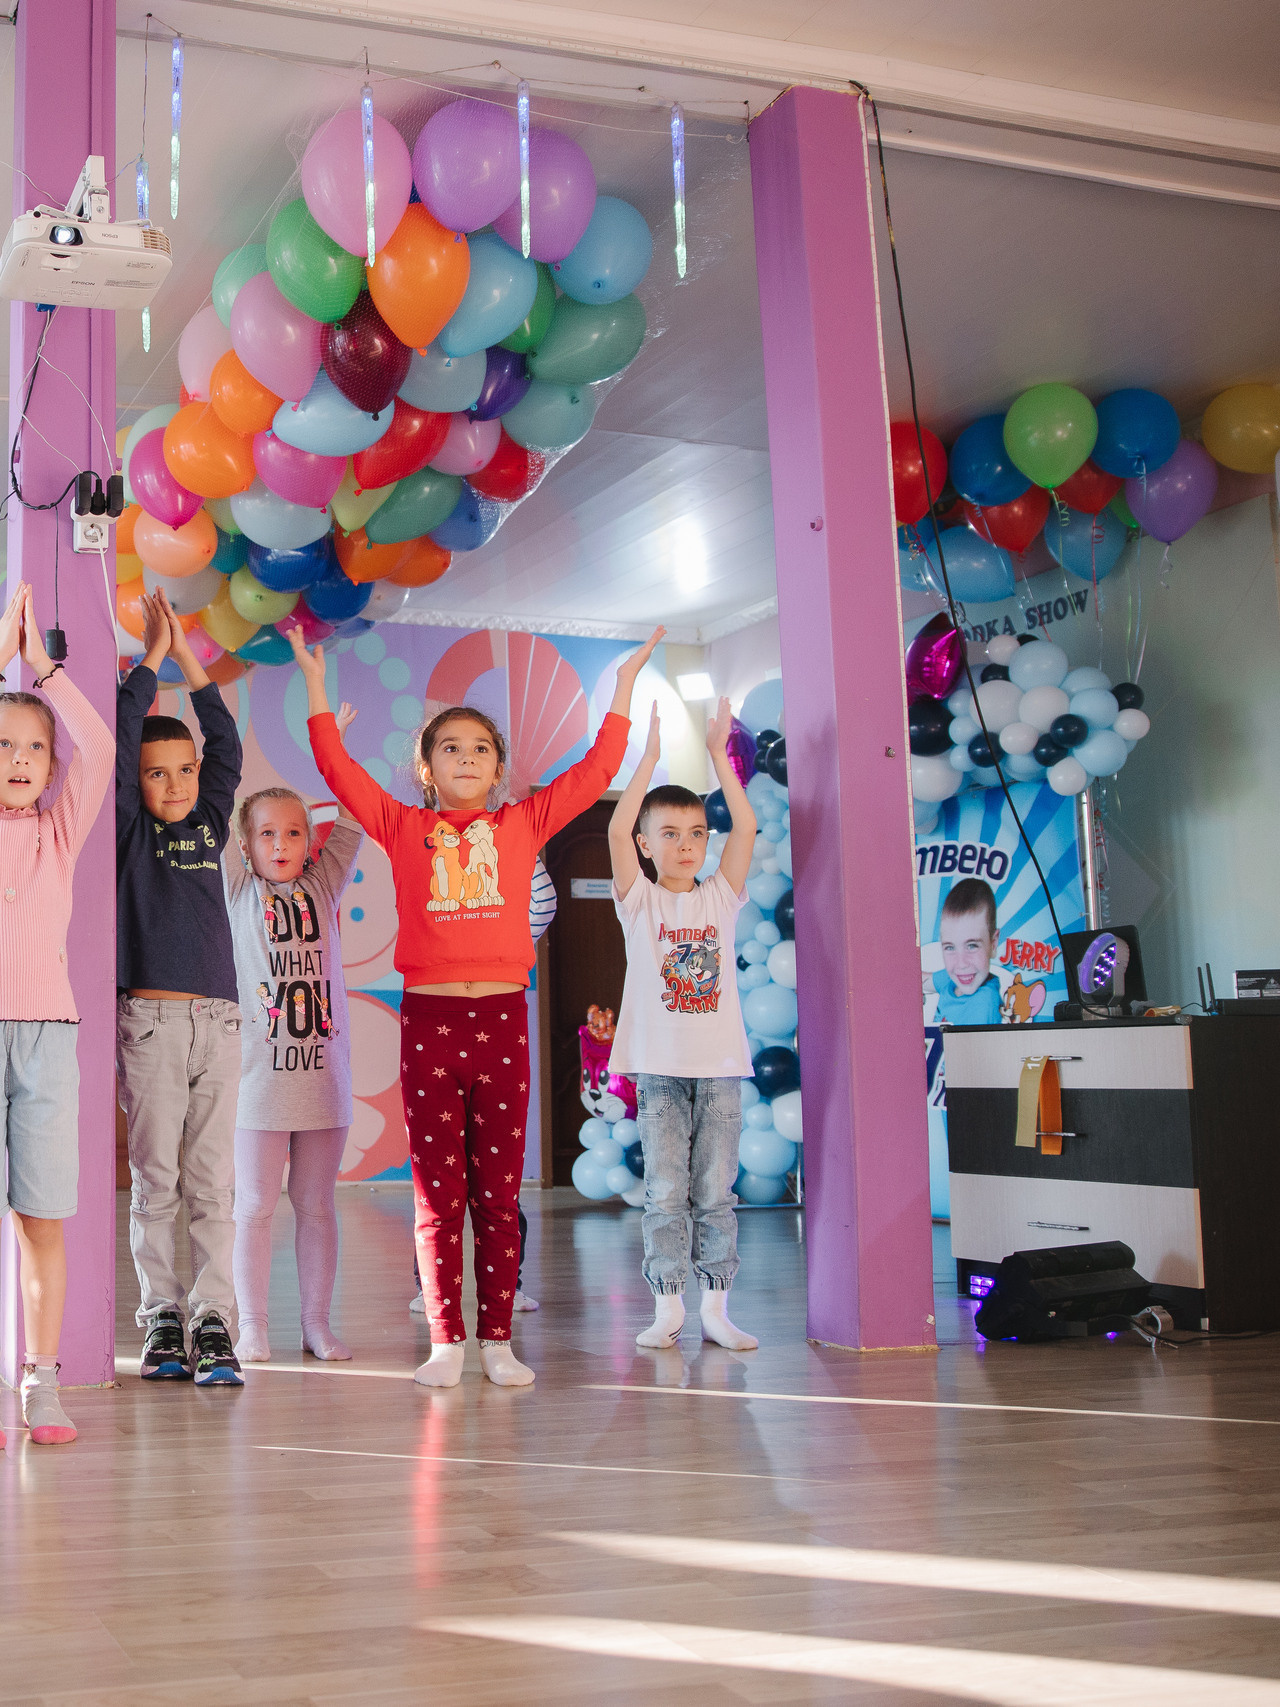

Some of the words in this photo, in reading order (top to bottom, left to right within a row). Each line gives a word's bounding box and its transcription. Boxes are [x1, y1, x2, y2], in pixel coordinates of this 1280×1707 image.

[1025, 588, 1089, 630] SHOW
[168, 840, 196, 851] PARIS
[269, 893, 320, 943] DO
[435, 915, 451, 923] LOVE
[463, 912, 480, 920] FIRST
[482, 911, 500, 919] SIGHT
[269, 950, 323, 977] WHAT
[677, 943, 693, 963] 7
[1000, 938, 1061, 974] JERRY
[260, 980, 333, 1039] YOU
[273, 1045, 324, 1071] LOVE
